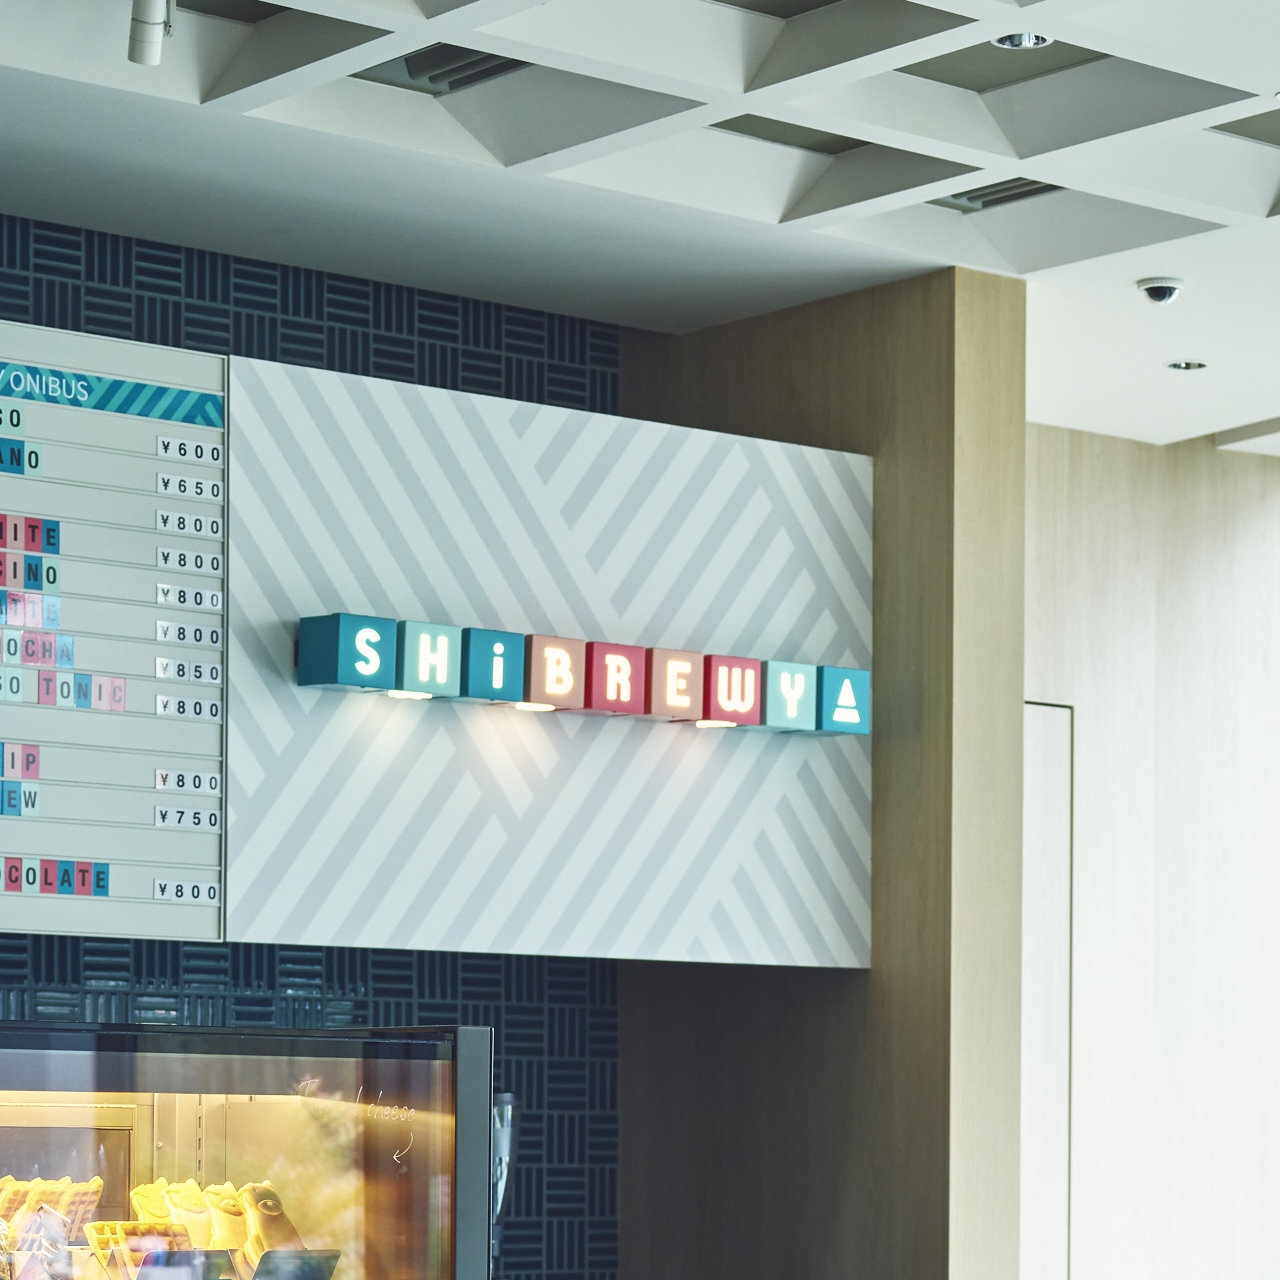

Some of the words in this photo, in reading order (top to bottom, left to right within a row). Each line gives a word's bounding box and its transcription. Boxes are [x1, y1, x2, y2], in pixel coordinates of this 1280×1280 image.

[11, 371, 89, 402] ONIBUS
[44, 677, 123, 704] TONIC
[367, 1090, 416, 1122] cheese
